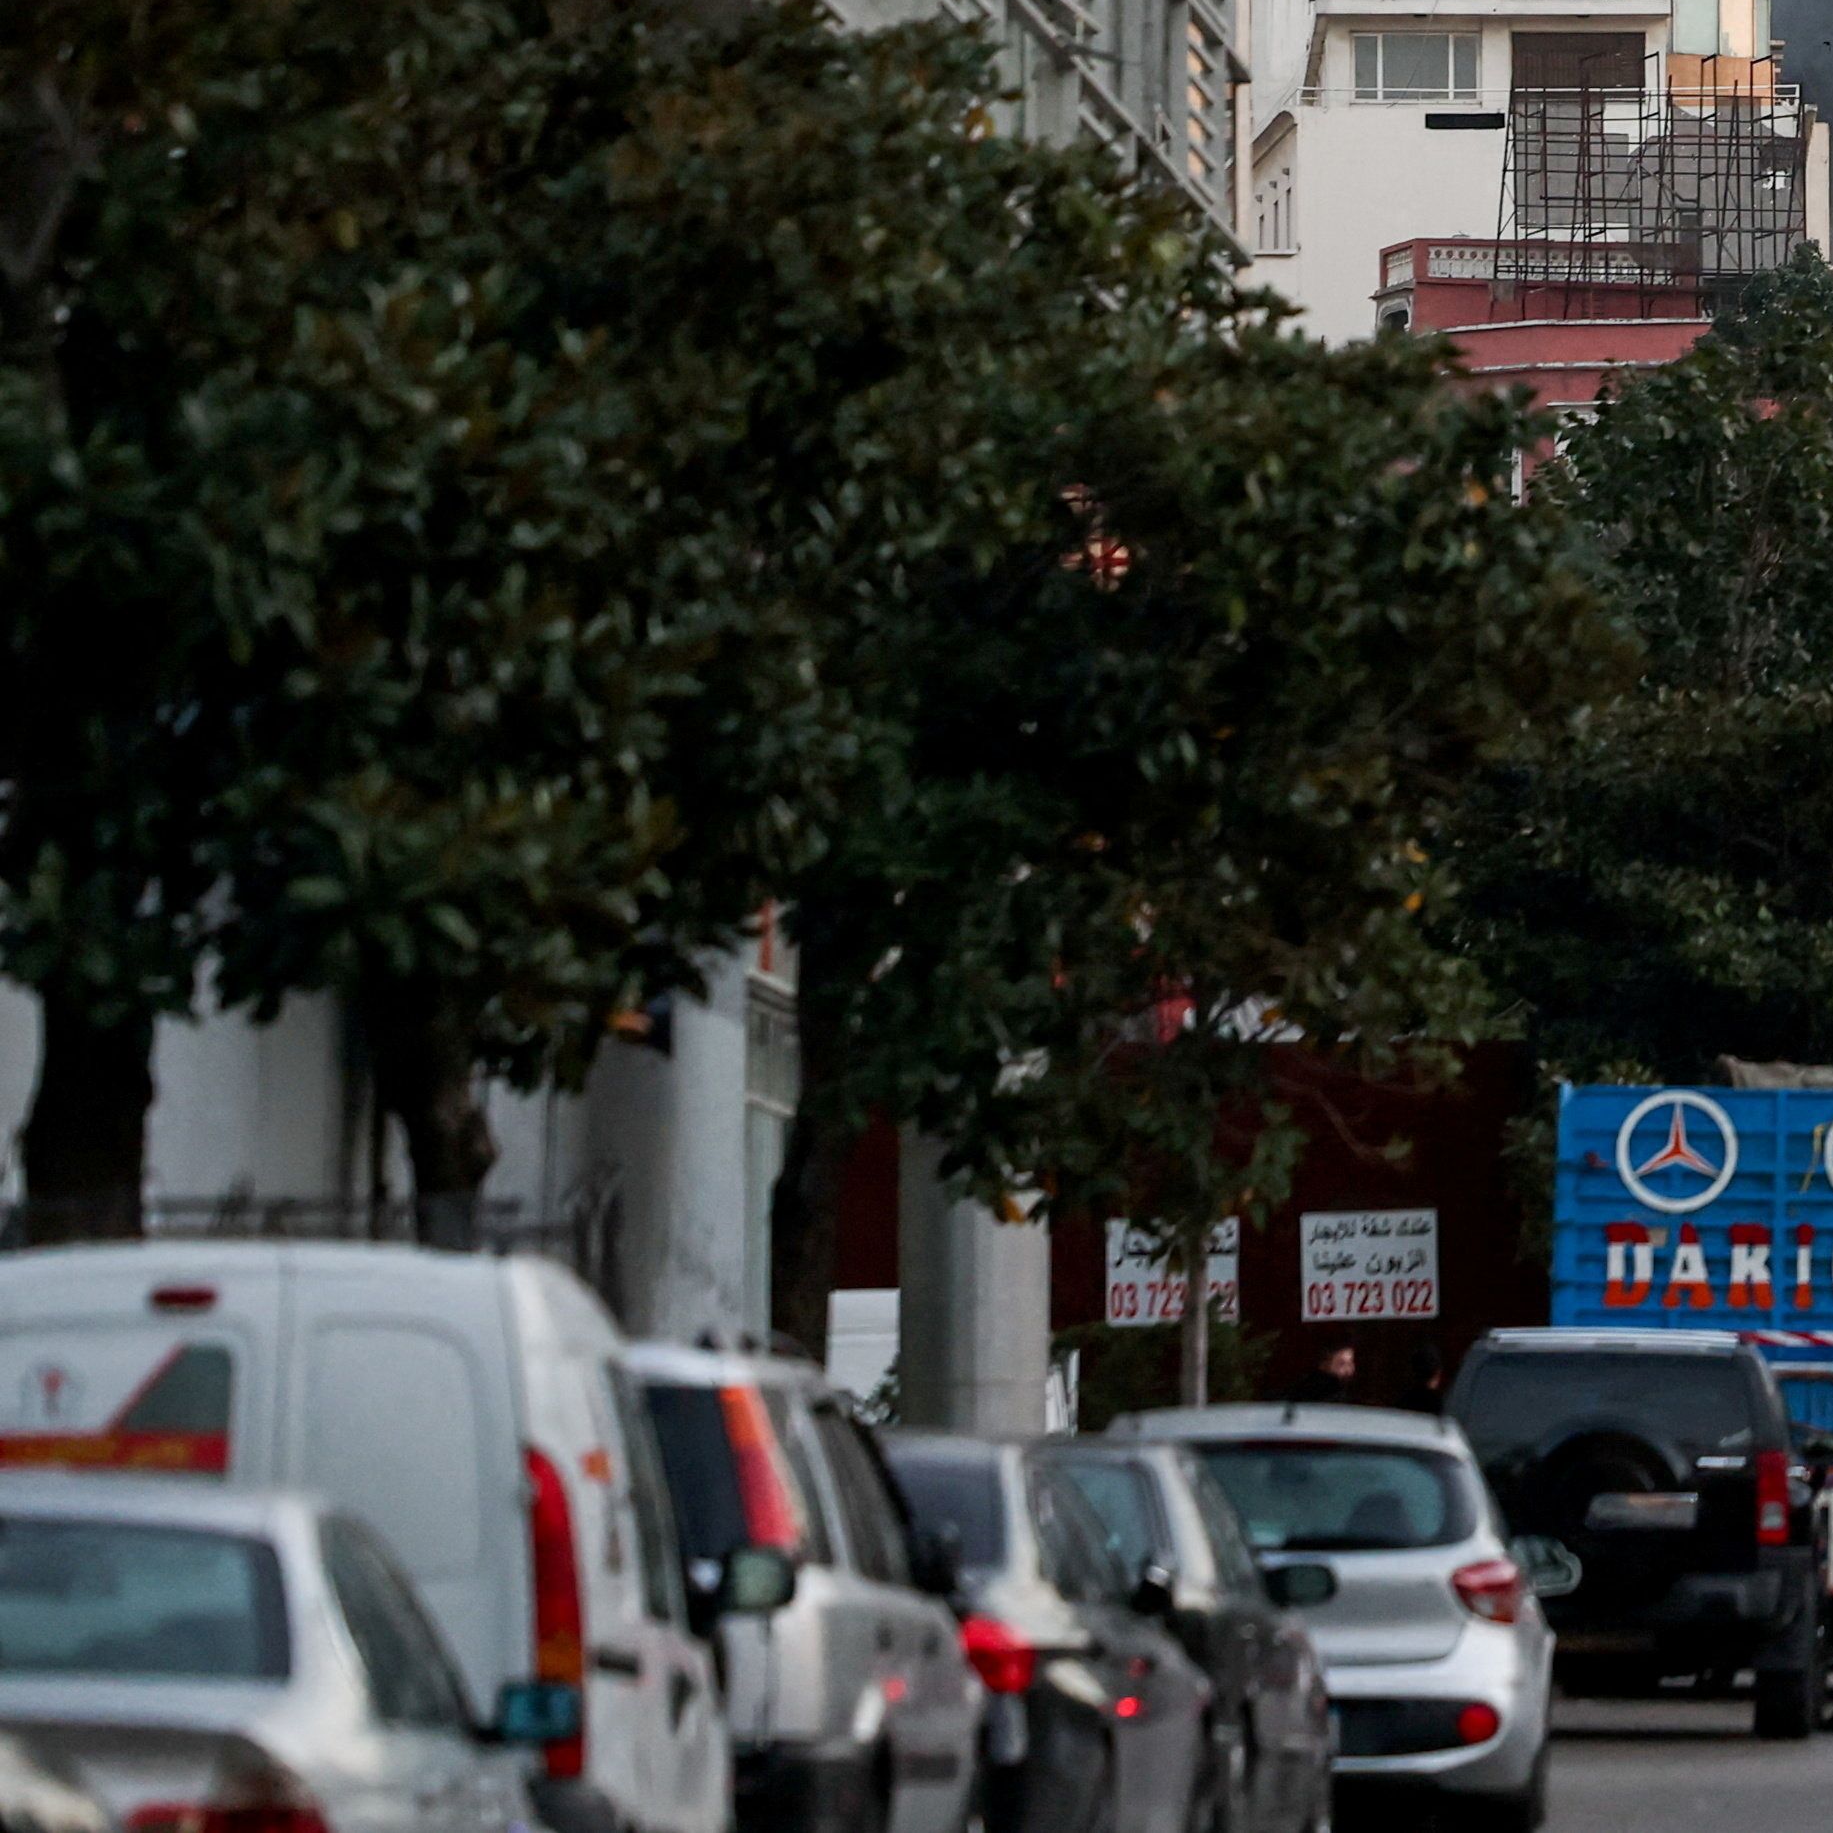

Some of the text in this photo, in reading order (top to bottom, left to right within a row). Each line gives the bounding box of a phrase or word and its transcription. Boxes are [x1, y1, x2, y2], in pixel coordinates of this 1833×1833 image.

[1361, 1214, 1391, 1237] شقة
[1111, 1282, 1138, 1318] 03
[1146, 1281, 1187, 1318] 723
[1307, 1278, 1434, 1315] 03 723 022
